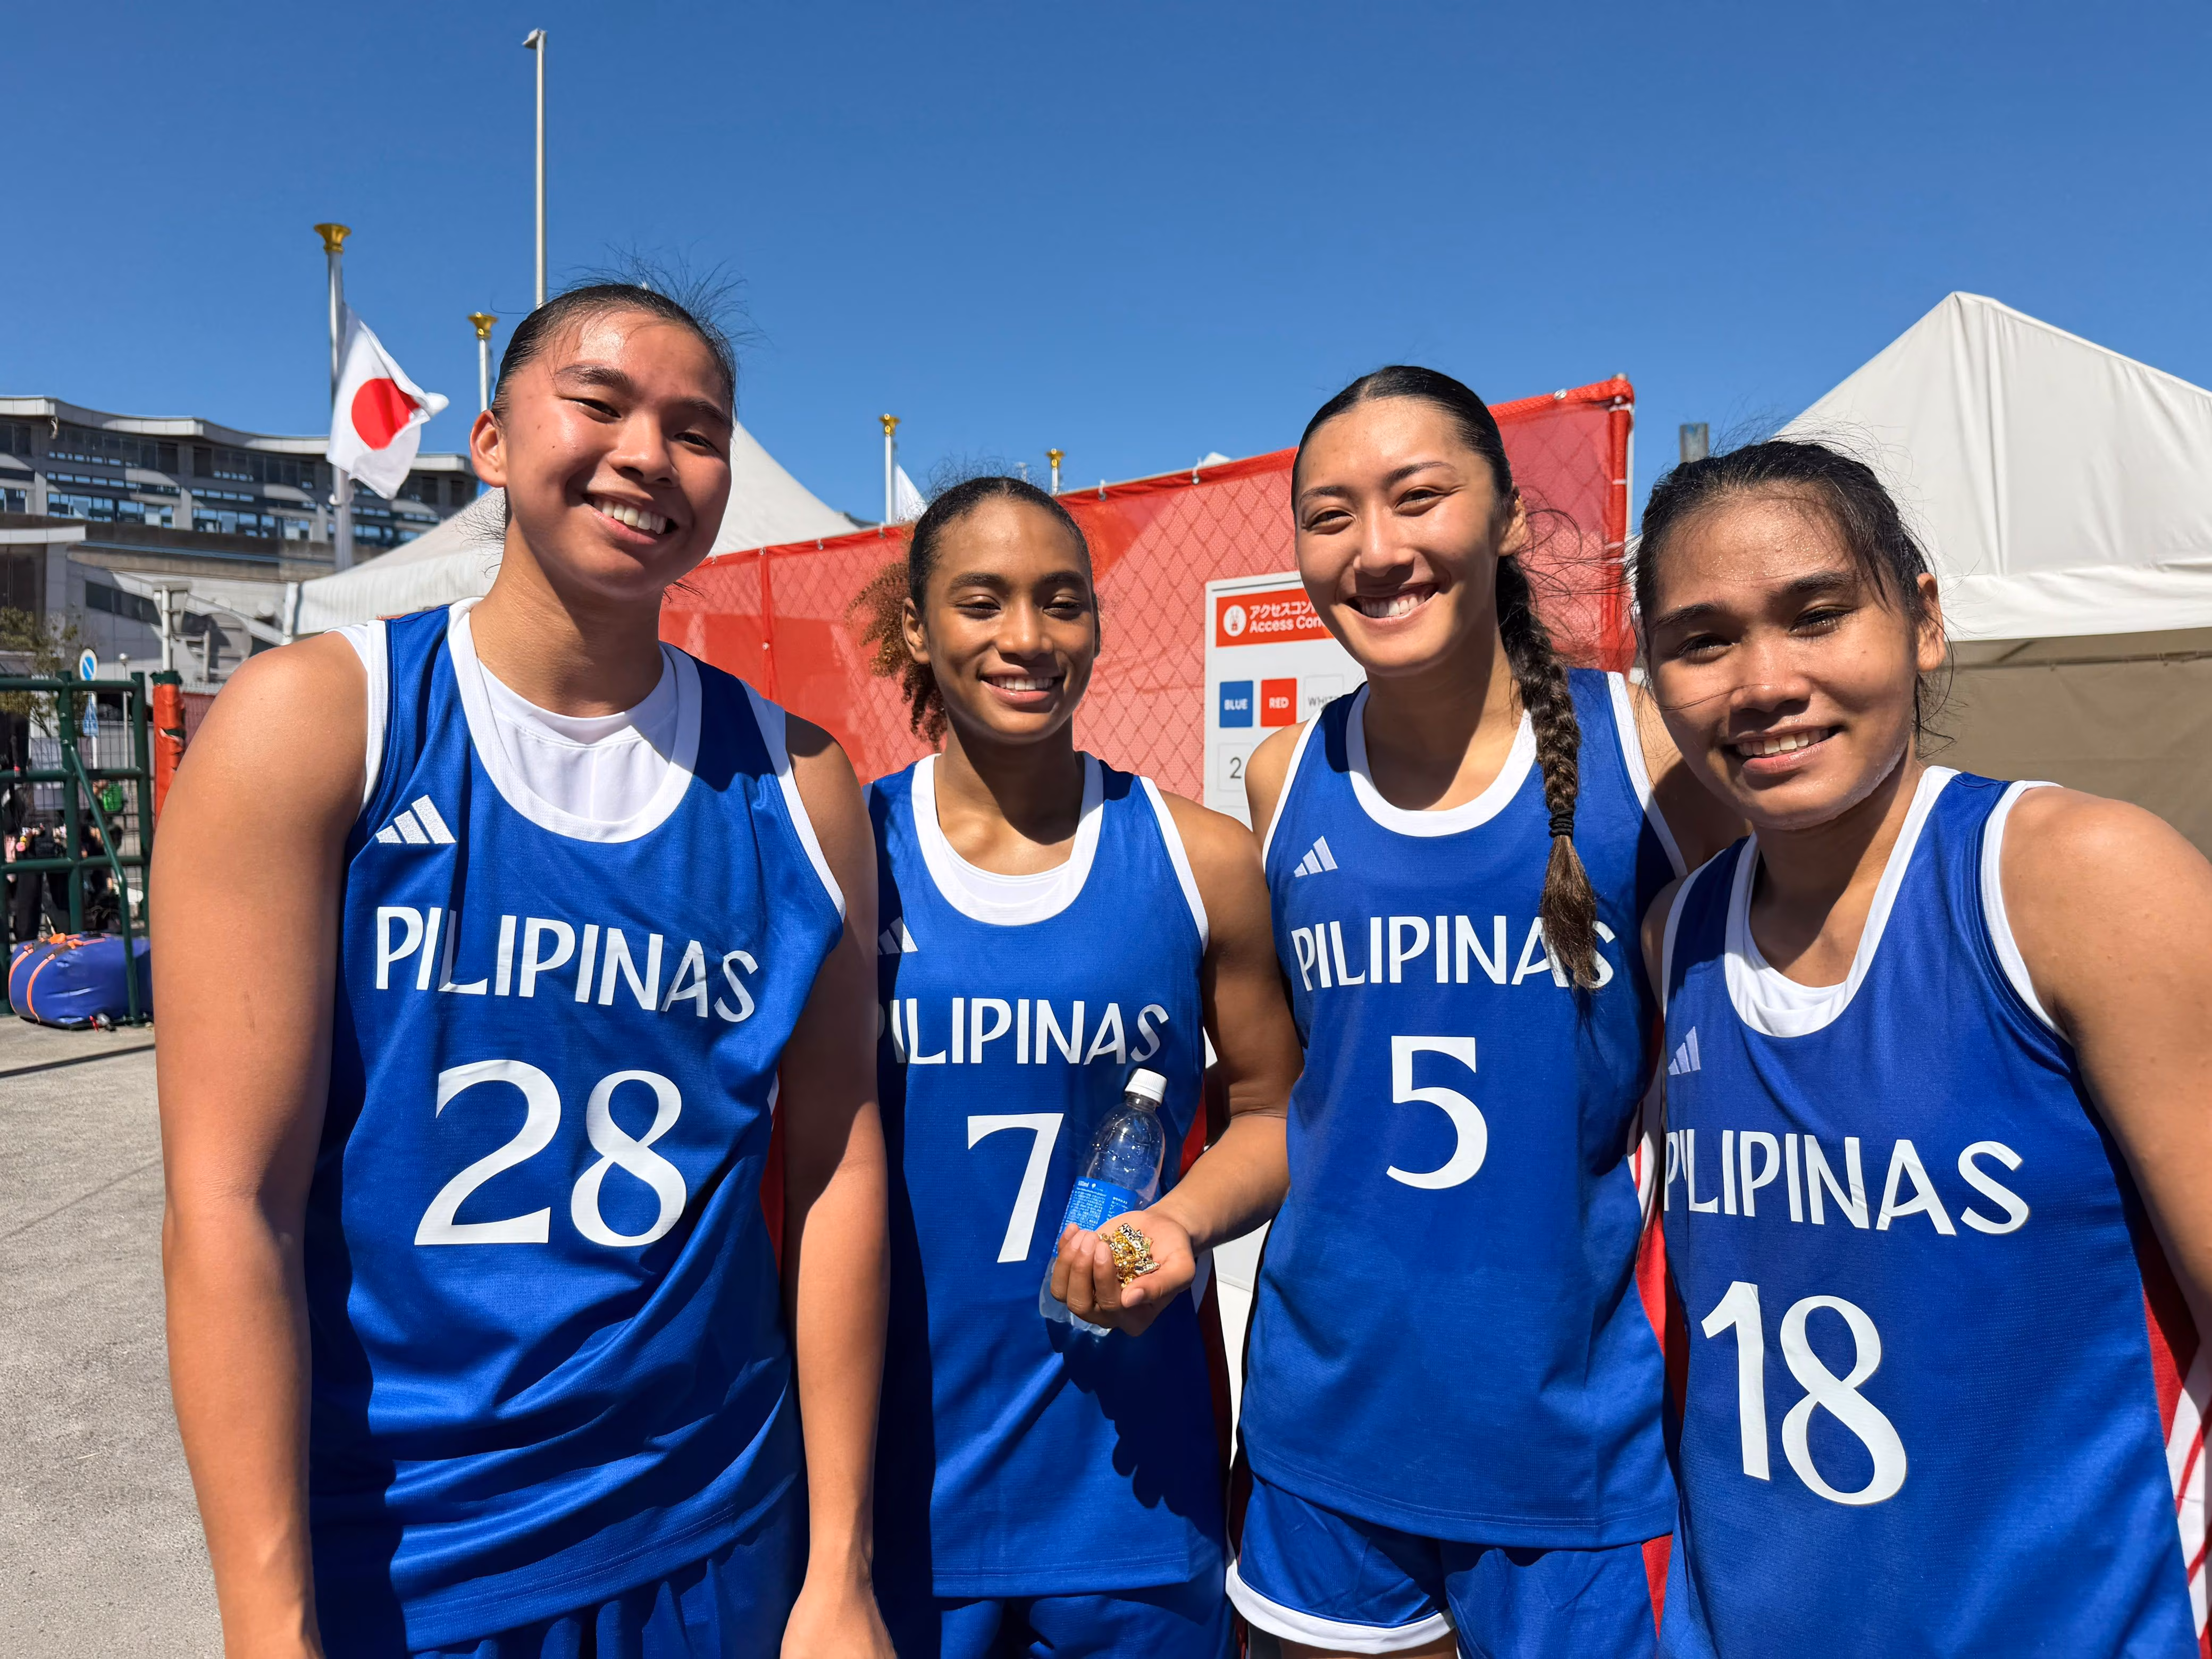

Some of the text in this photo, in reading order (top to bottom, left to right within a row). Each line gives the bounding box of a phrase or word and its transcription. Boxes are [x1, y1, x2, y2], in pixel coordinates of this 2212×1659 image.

[1249, 615, 1323, 633] Access Con
[1224, 698, 1248, 710] BLUE
[1268, 697, 1289, 709] RED
[1230, 757, 1242, 779] 2
[375, 907, 758, 1022] PILIPINAS
[1291, 915, 1615, 991] PILIPINAS
[878, 997, 1169, 1065] ILIPINAS
[414, 1059, 687, 1247] 28
[1386, 1035, 1488, 1189] 5
[968, 1113, 1063, 1263] 7
[1664, 1129, 2029, 1235] PILIPINAS
[1701, 1281, 1906, 1505] 18
